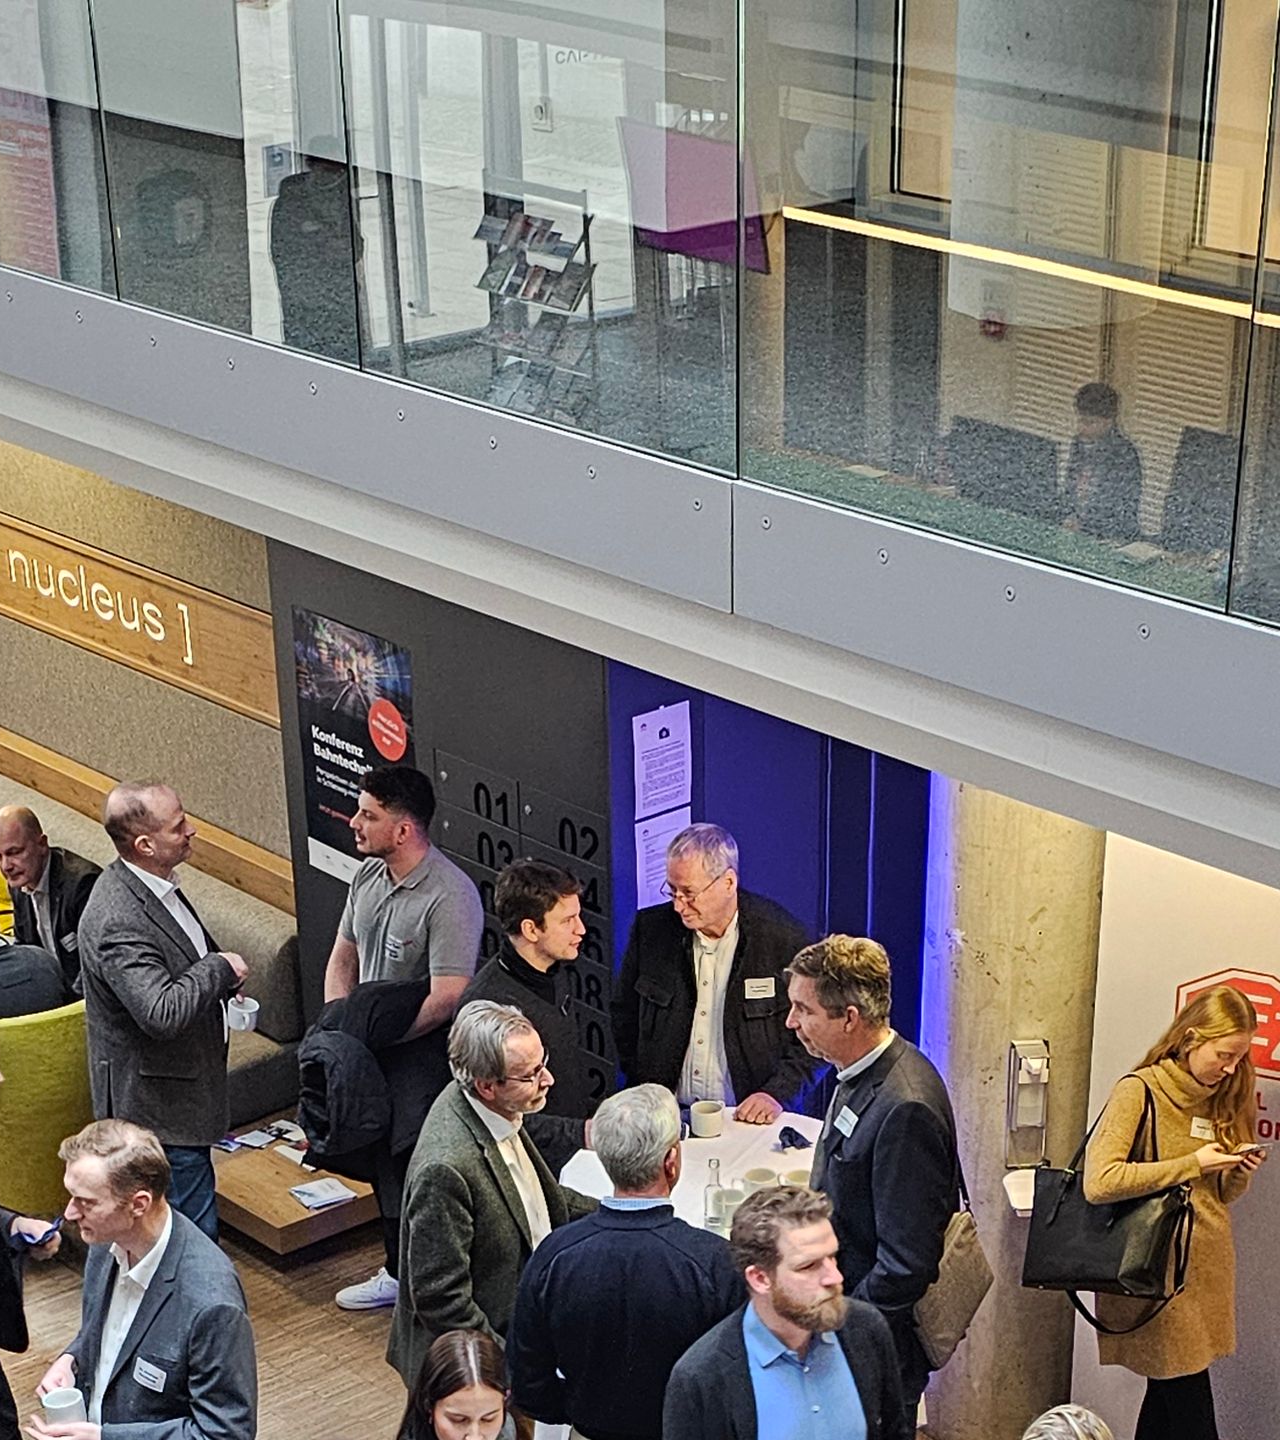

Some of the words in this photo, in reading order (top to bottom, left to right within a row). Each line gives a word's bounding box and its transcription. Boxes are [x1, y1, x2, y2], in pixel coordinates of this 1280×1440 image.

[7, 548, 166, 642] nucleus
[311, 724, 364, 758] Konferenz
[473, 782, 509, 828] 01
[477, 831, 514, 869] 03
[558, 817, 599, 861] 02
[480, 880, 497, 915] 0
[582, 878, 602, 914] 4
[584, 926, 603, 965] 6
